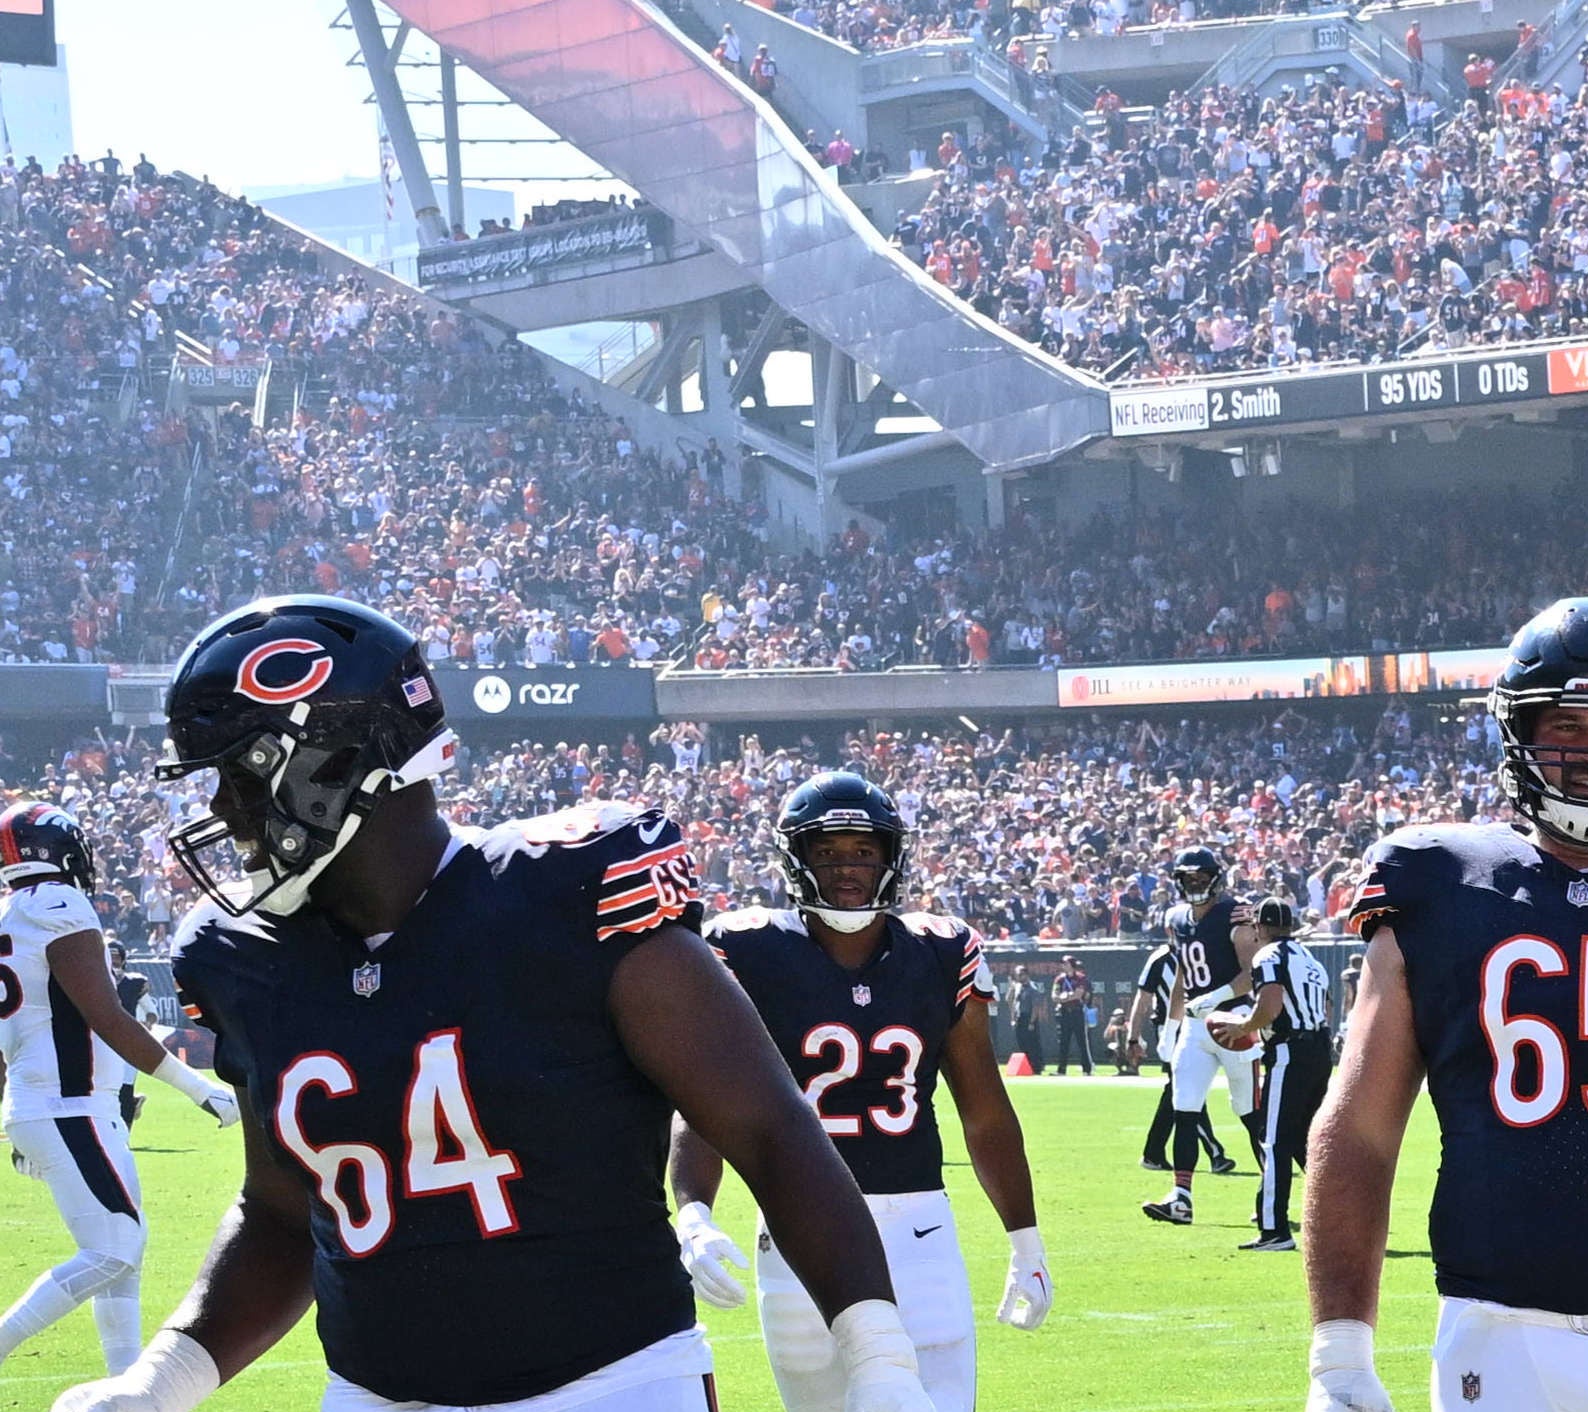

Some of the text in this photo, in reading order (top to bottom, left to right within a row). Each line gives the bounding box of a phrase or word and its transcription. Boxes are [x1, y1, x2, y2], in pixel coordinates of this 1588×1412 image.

[1380, 369, 1442, 404] 95 YDS
[1478, 362, 1529, 395] 0 TDs
[1115, 401, 1205, 426] NFL Receiving
[1211, 387, 1281, 422] 2. Smith
[519, 683, 581, 705] razr
[801, 1021, 927, 1137] 23
[273, 1026, 524, 1259] 64
